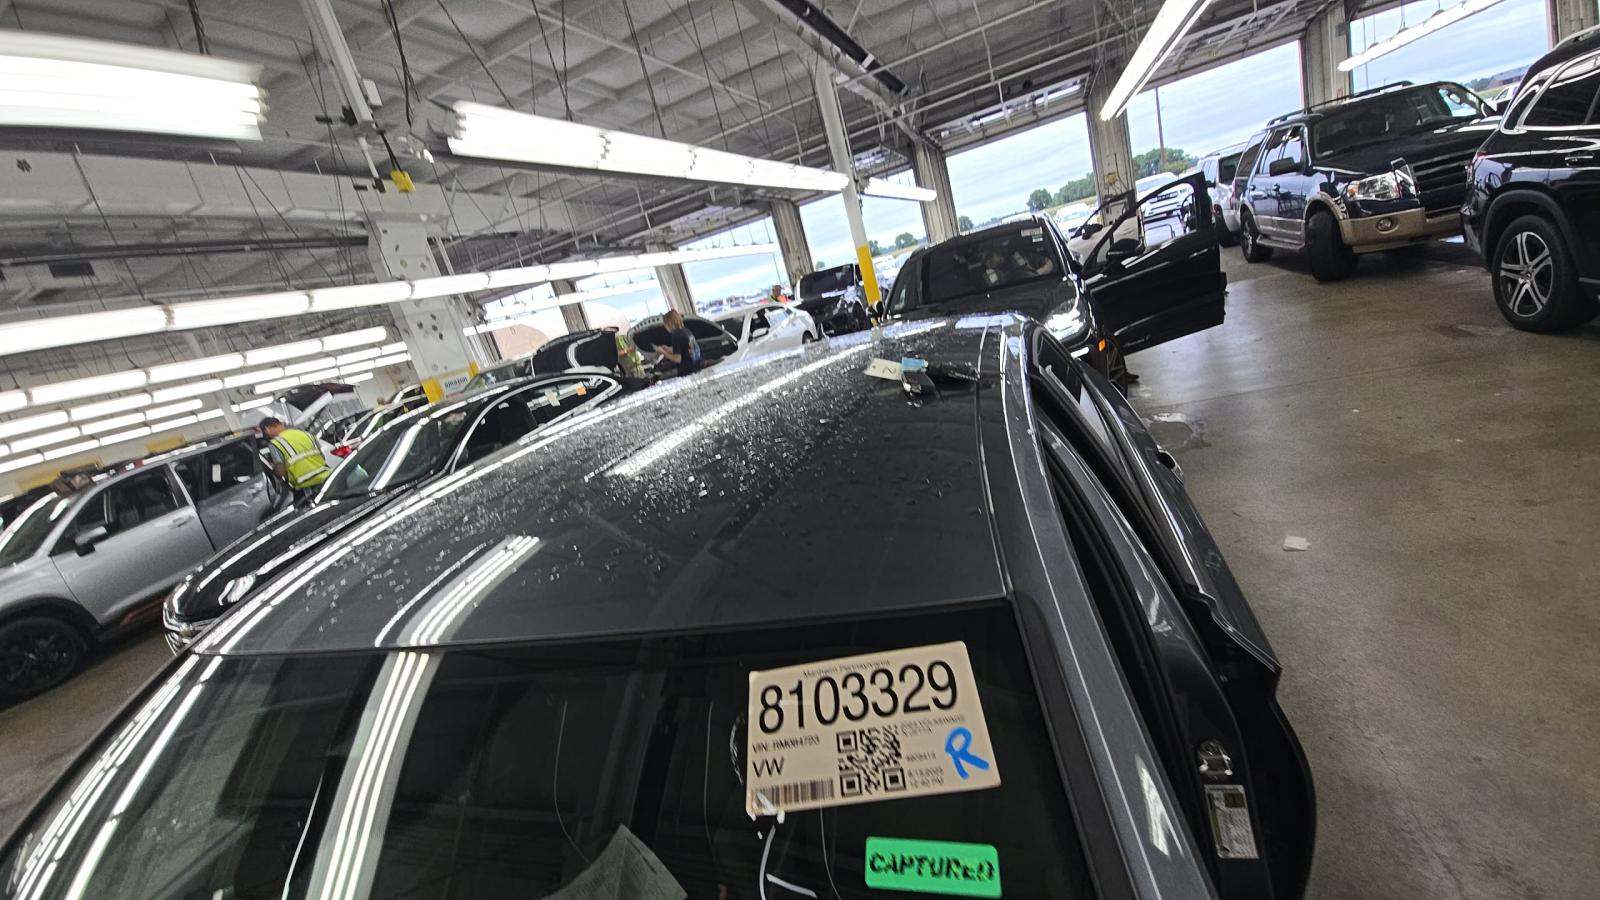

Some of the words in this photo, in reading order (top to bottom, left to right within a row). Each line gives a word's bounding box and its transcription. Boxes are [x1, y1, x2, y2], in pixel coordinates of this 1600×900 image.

[758, 660, 958, 734] 8103329
[752, 756, 785, 778] VW
[945, 727, 990, 780] R
